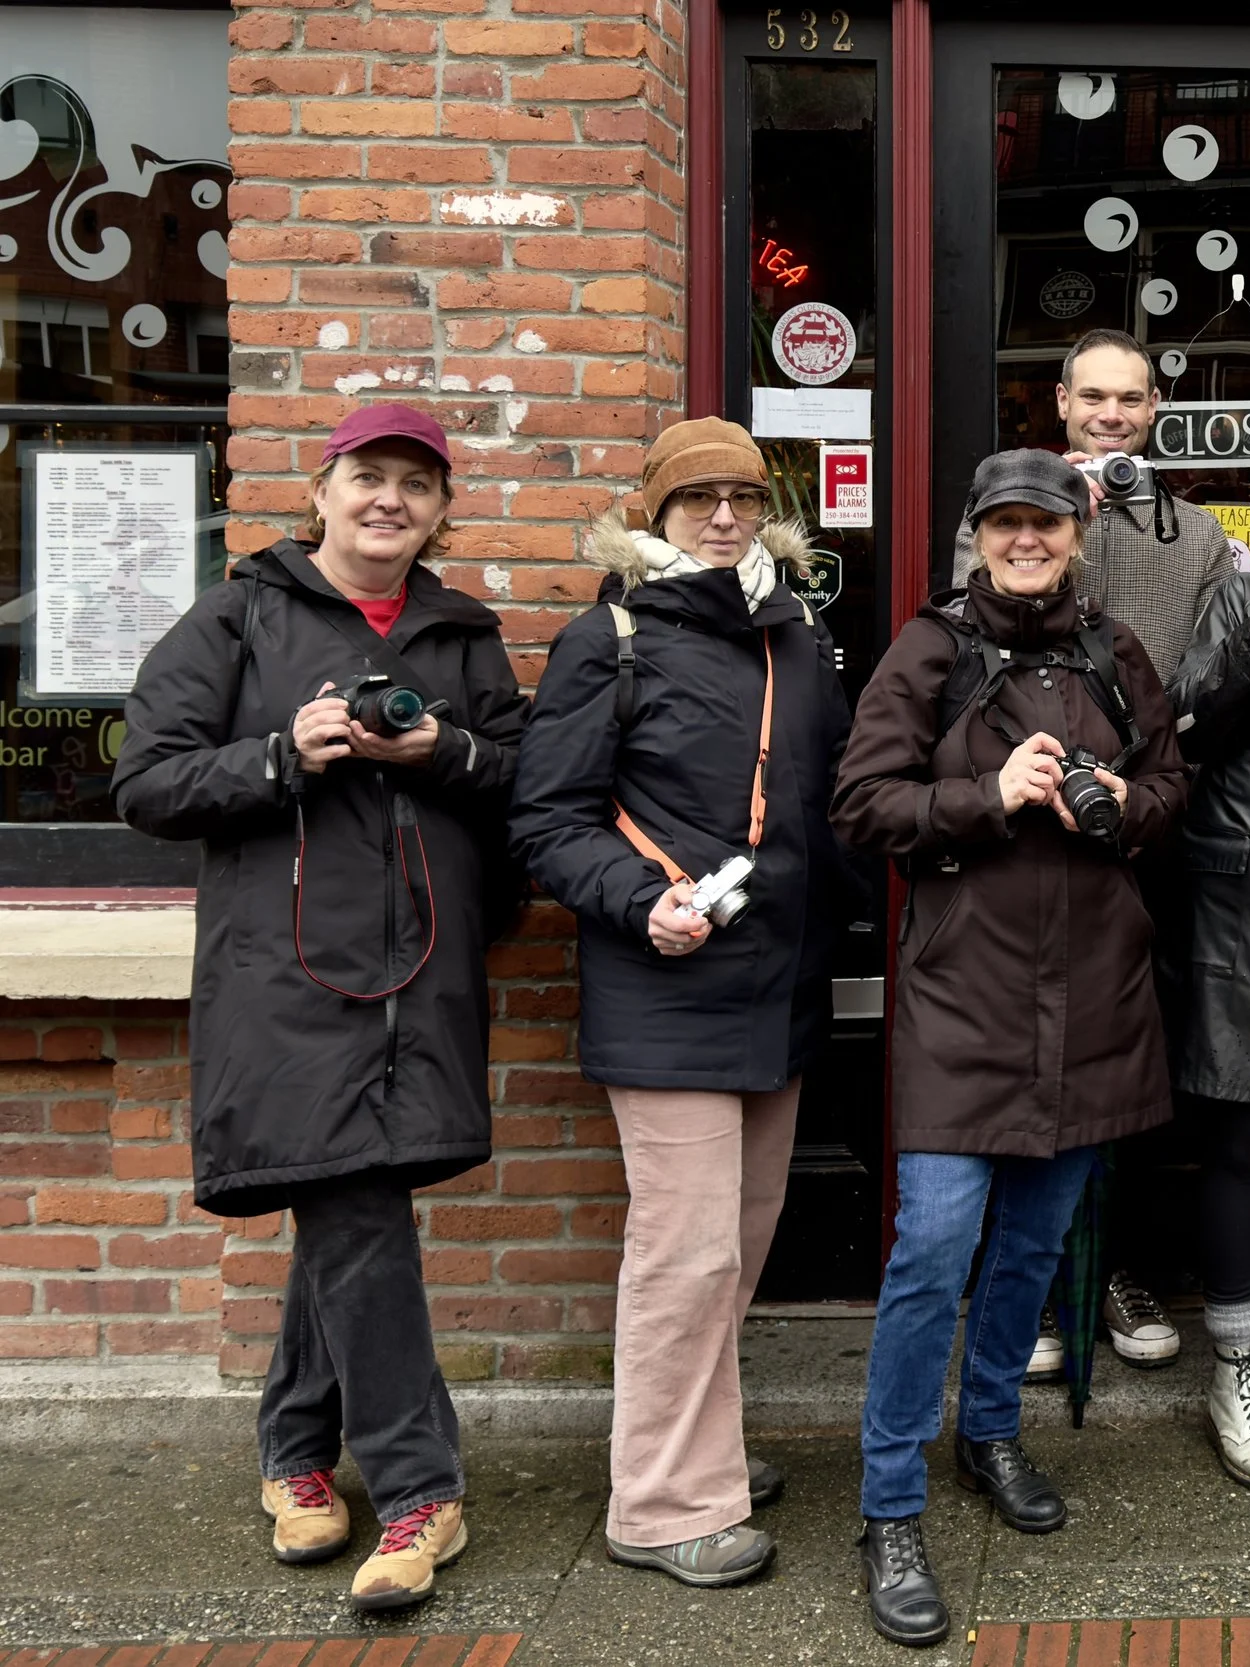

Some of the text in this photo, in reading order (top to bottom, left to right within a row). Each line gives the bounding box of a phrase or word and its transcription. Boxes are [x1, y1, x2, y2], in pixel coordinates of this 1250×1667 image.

[767, 8, 851, 51] 532
[759, 239, 808, 287] TEA
[797, 303, 826, 315] OLDEST
[827, 306, 855, 346] CHINATOWN
[838, 486, 867, 497] PRICE'S
[838, 498, 867, 508] ALARMS
[798, 590, 831, 602] icinity
[0, 739, 48, 766] bar
